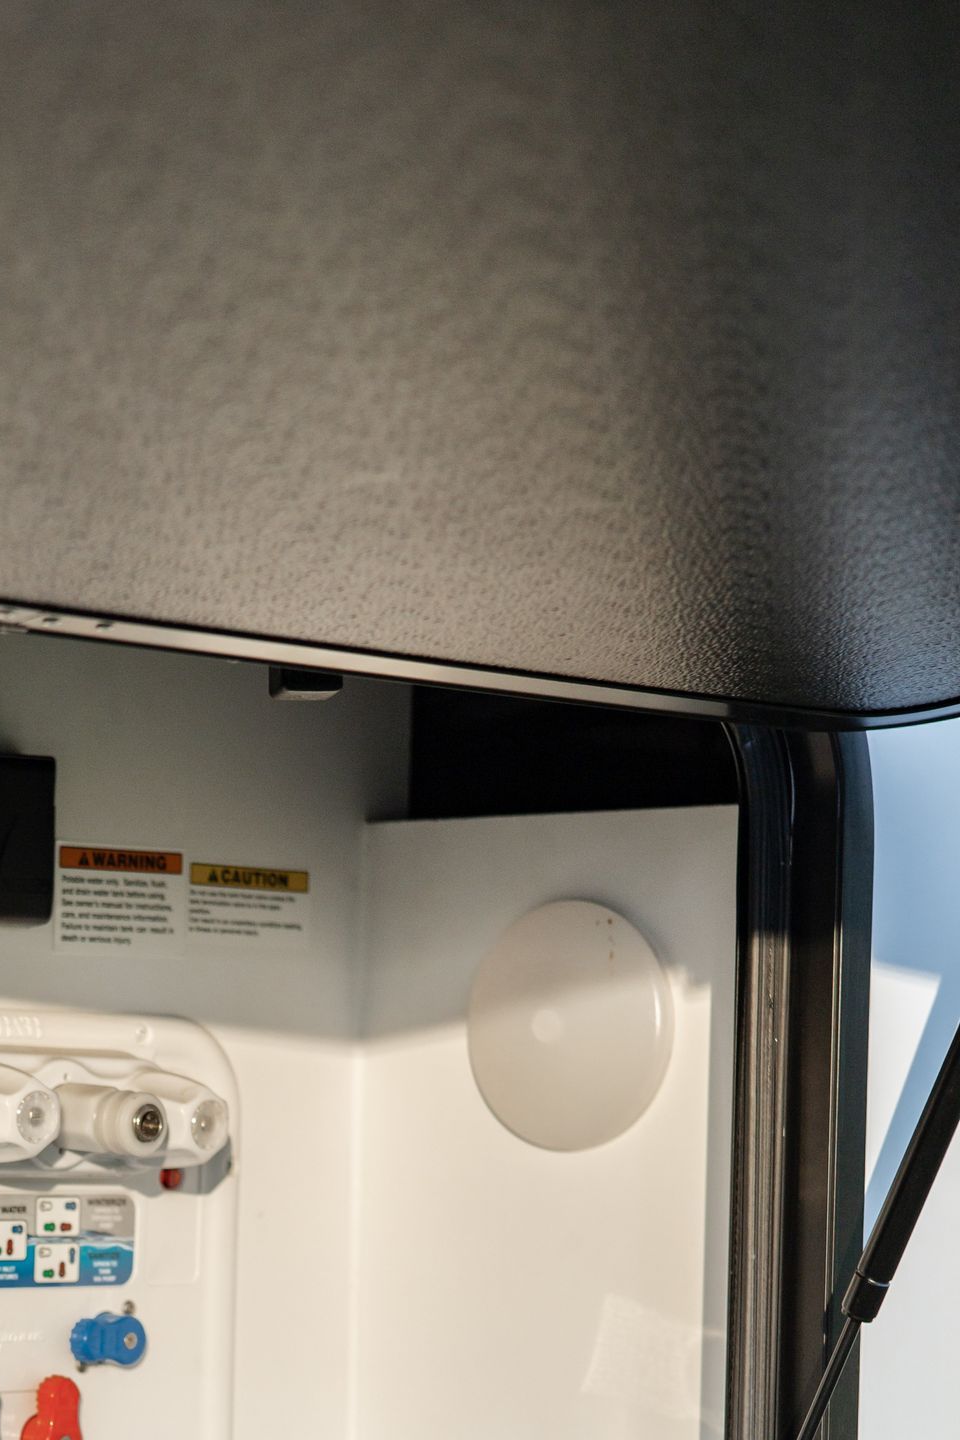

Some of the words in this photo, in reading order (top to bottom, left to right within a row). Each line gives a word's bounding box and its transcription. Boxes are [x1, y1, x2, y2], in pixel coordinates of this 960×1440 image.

[90, 852, 167, 870] WARNING
[220, 868, 289, 887] CAUTION
[1, 1206, 27, 1214] WATER
